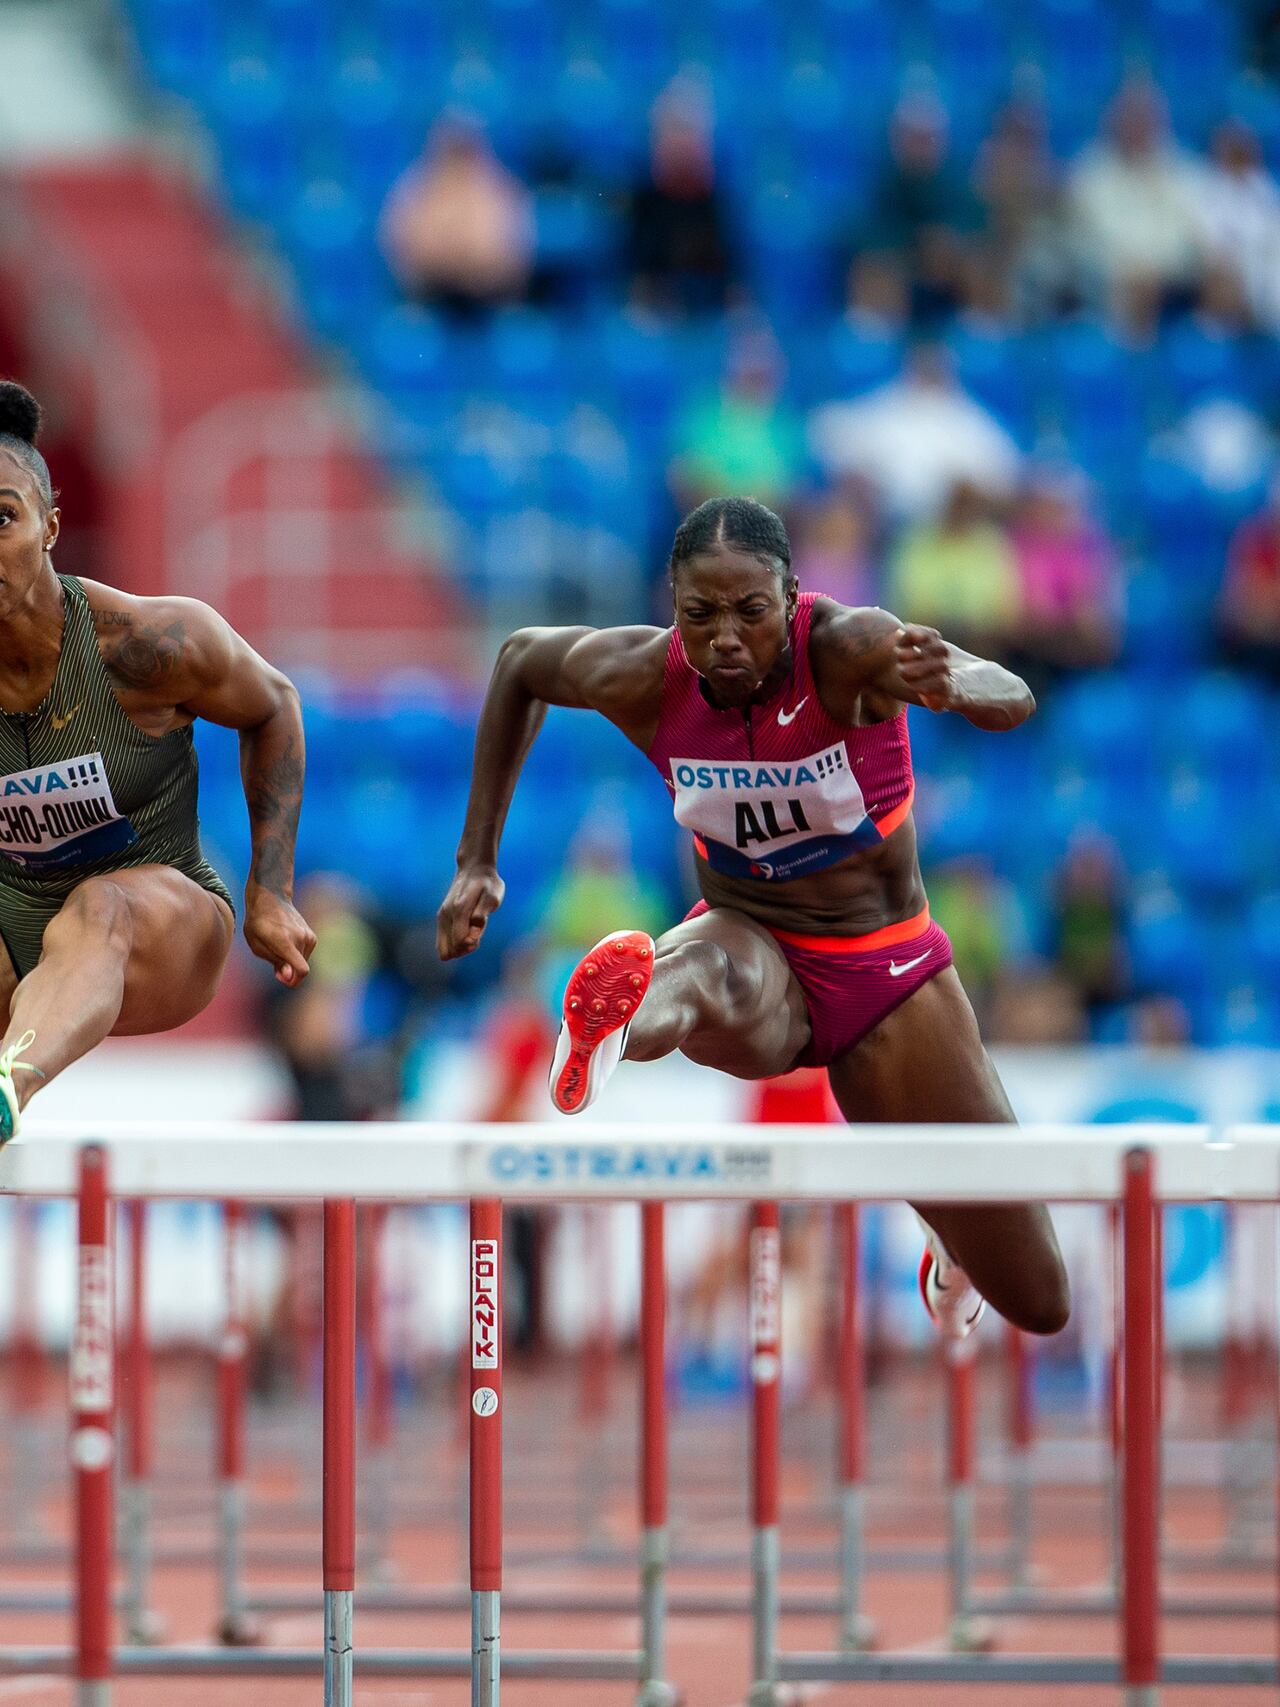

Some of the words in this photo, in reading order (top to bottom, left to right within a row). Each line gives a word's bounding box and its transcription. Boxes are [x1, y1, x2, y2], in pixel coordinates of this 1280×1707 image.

[676, 750, 843, 788] OSTRAVA!!!
[735, 799, 811, 848] ALI
[474, 1243, 496, 1358] POLANIK
